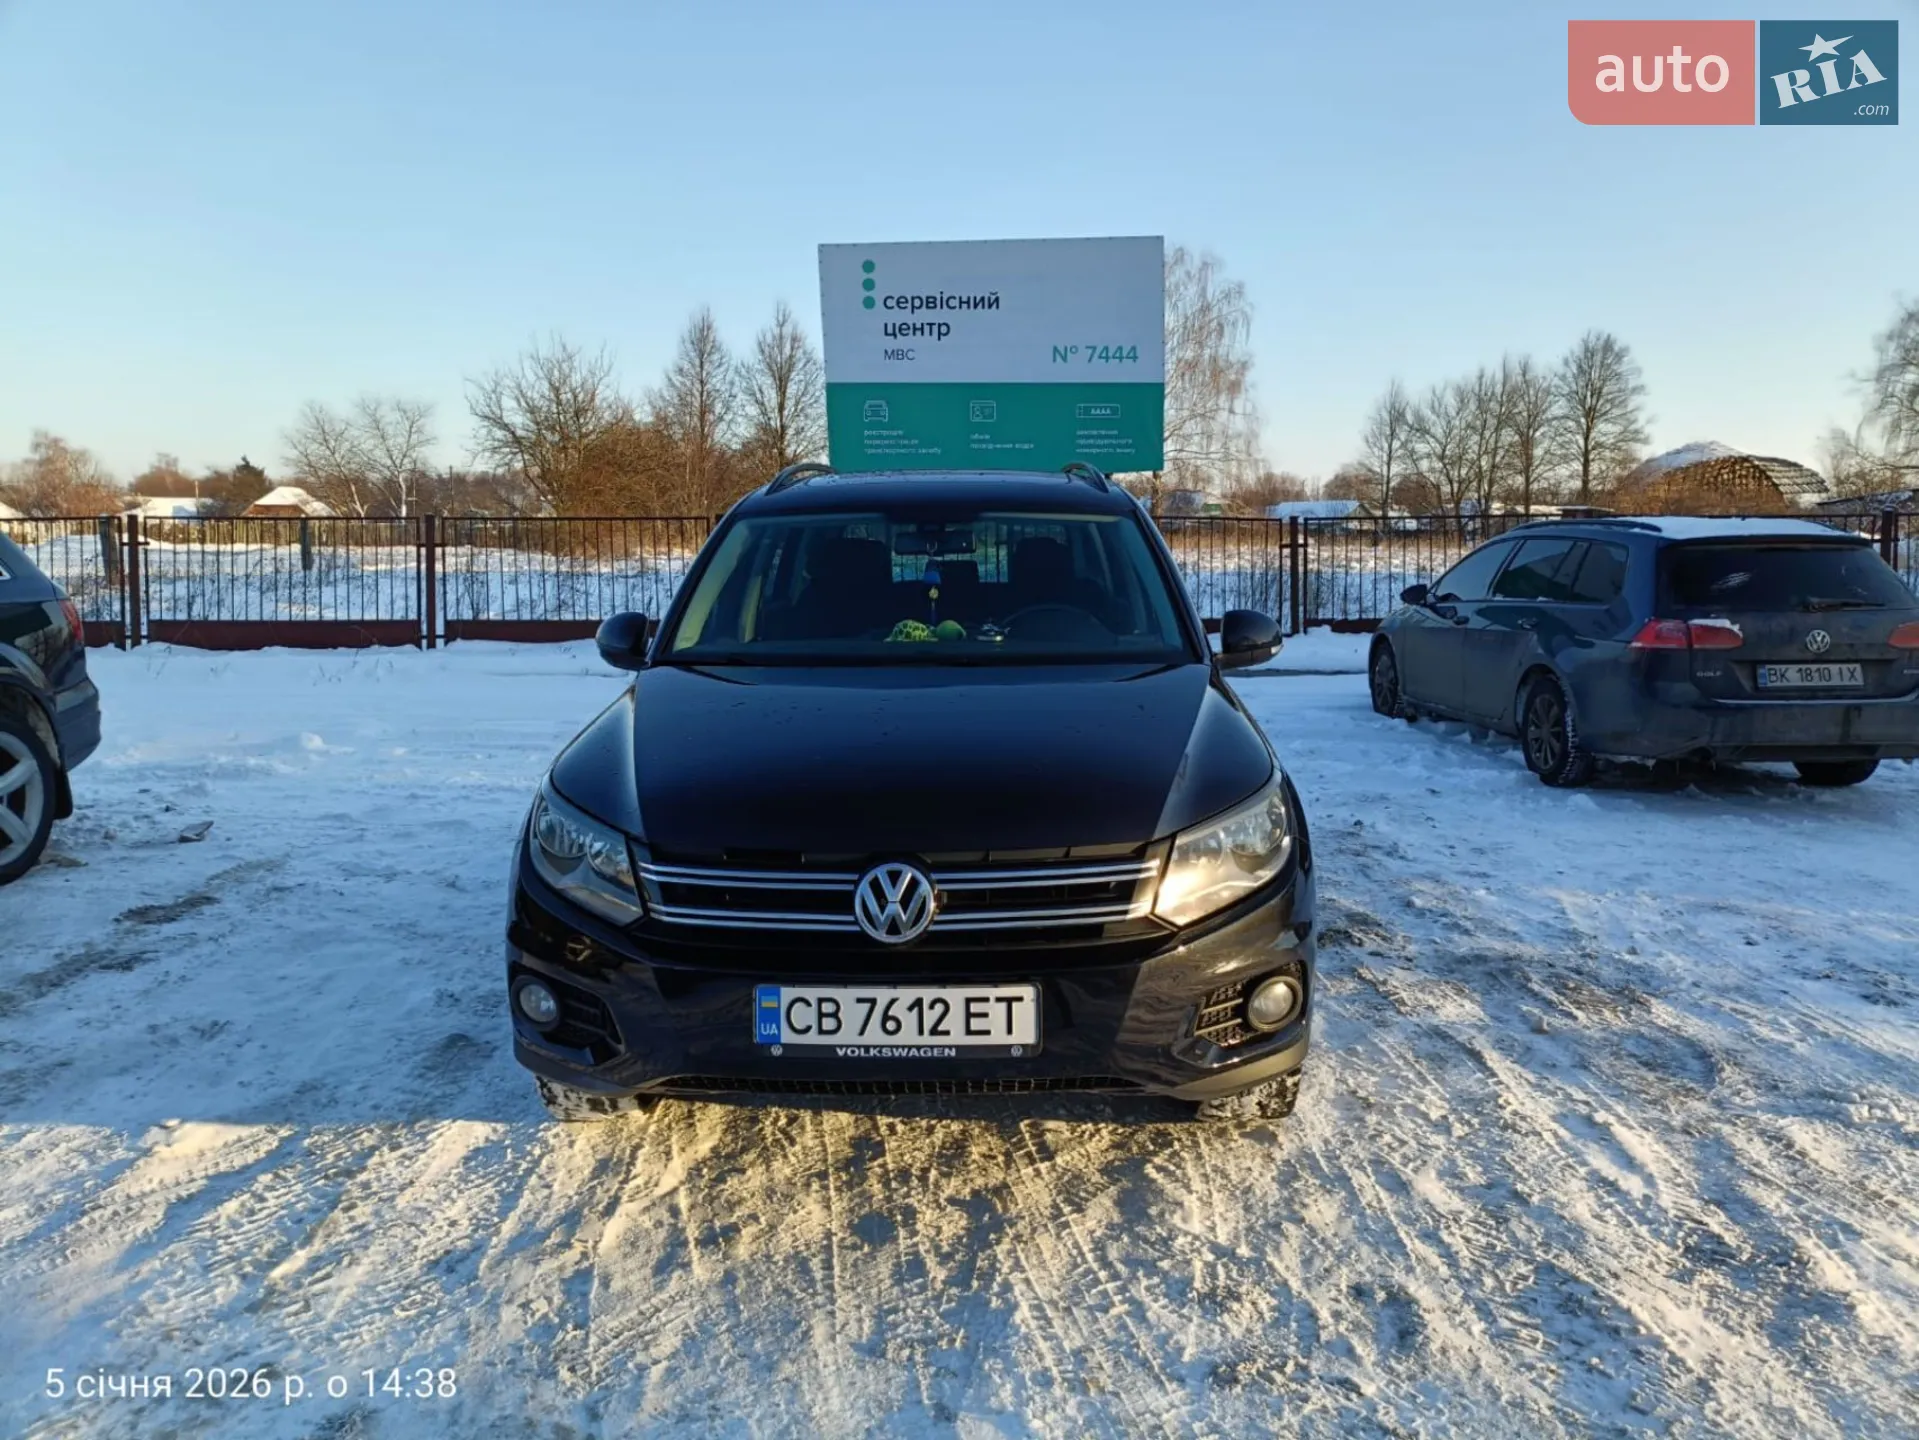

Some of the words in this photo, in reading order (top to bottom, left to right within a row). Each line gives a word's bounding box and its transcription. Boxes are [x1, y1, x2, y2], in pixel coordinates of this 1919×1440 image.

[883, 291, 1000, 314] сервісний
[883, 321, 951, 341] центр
[884, 348, 916, 361] МВС
[1085, 345, 1139, 364] 7444
[1767, 667, 1790, 683] BK
[1796, 667, 1832, 683] 1810
[785, 996, 843, 1036] CB
[855, 996, 951, 1036] 7612
[964, 996, 1025, 1036] ET
[760, 1023, 779, 1036] UA
[835, 1046, 957, 1058] VOLKSWAGEN
